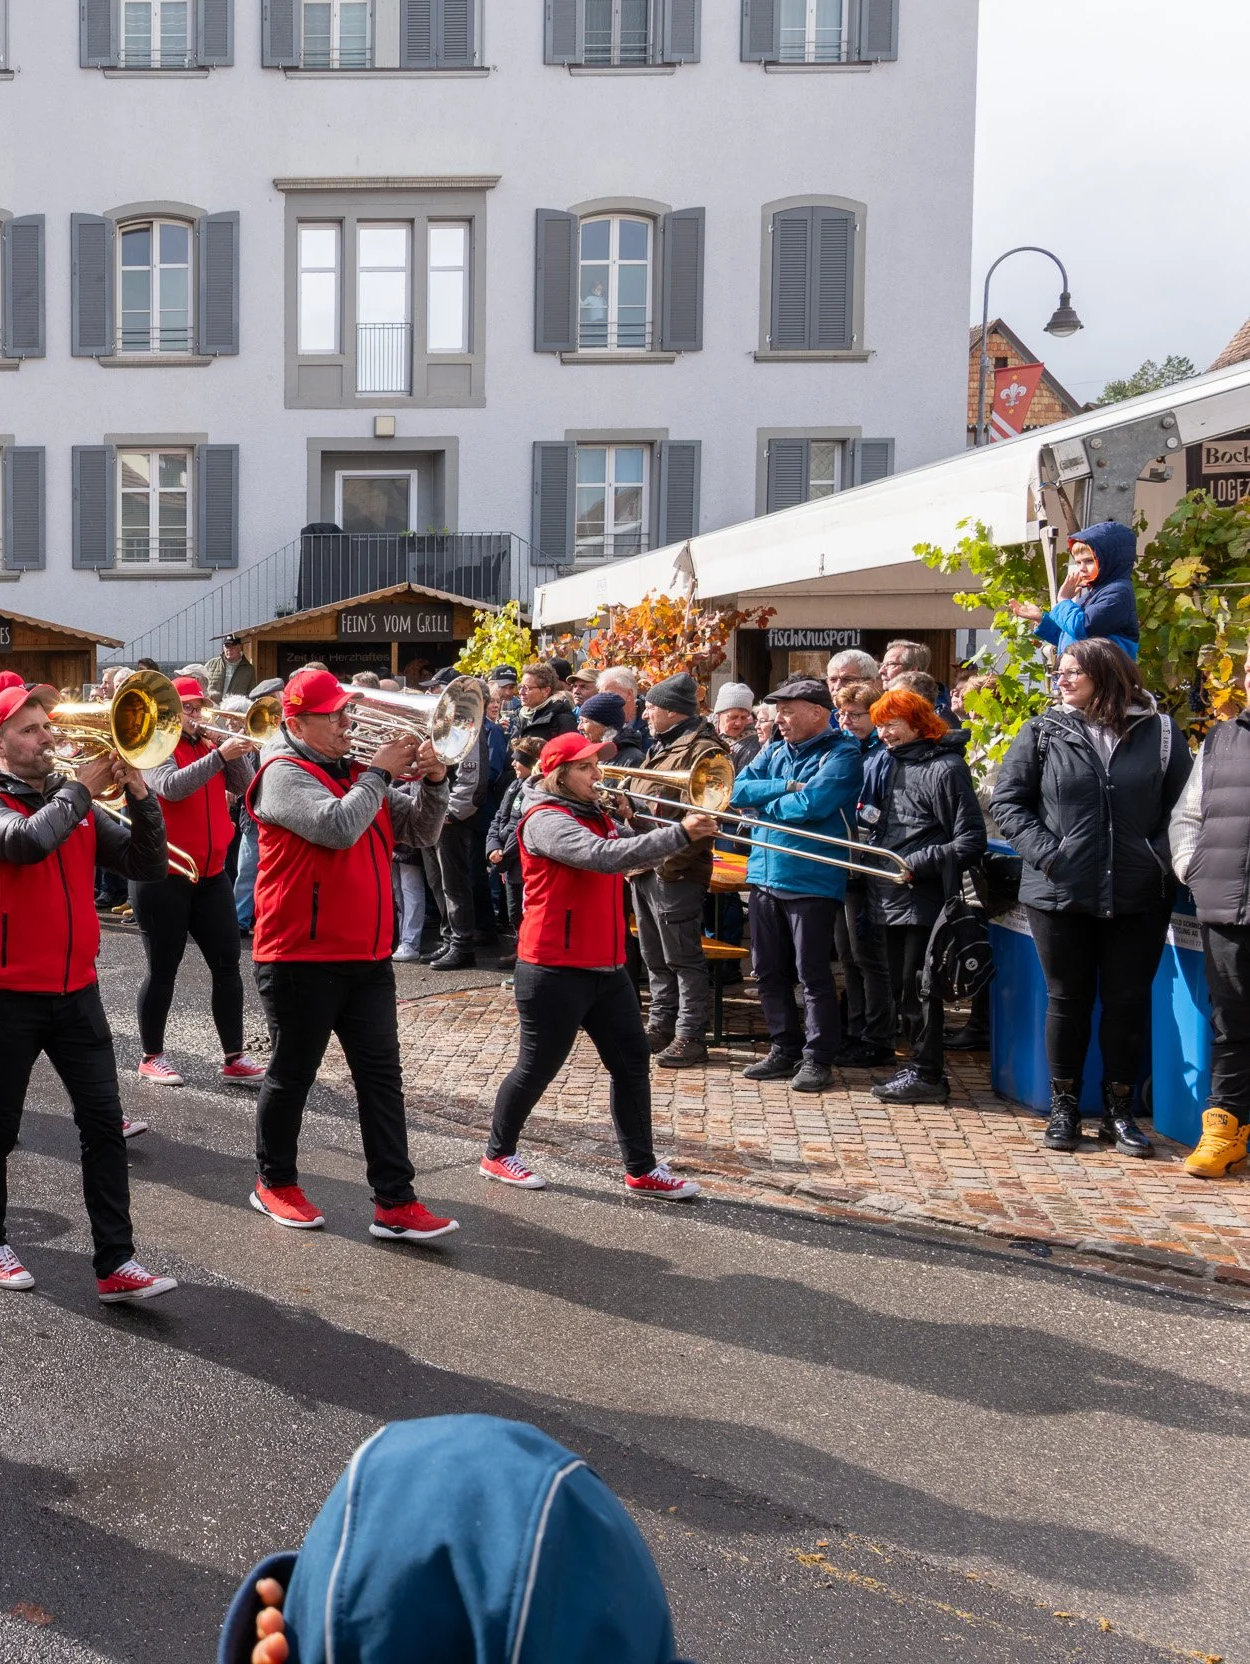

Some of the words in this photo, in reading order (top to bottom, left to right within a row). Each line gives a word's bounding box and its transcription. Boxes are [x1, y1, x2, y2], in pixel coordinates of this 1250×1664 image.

[341, 613, 377, 633] FEIN'S
[416, 612, 449, 633] GRILL
[286, 652, 307, 662] Zeit
[329, 652, 390, 662] Herzhaftes
